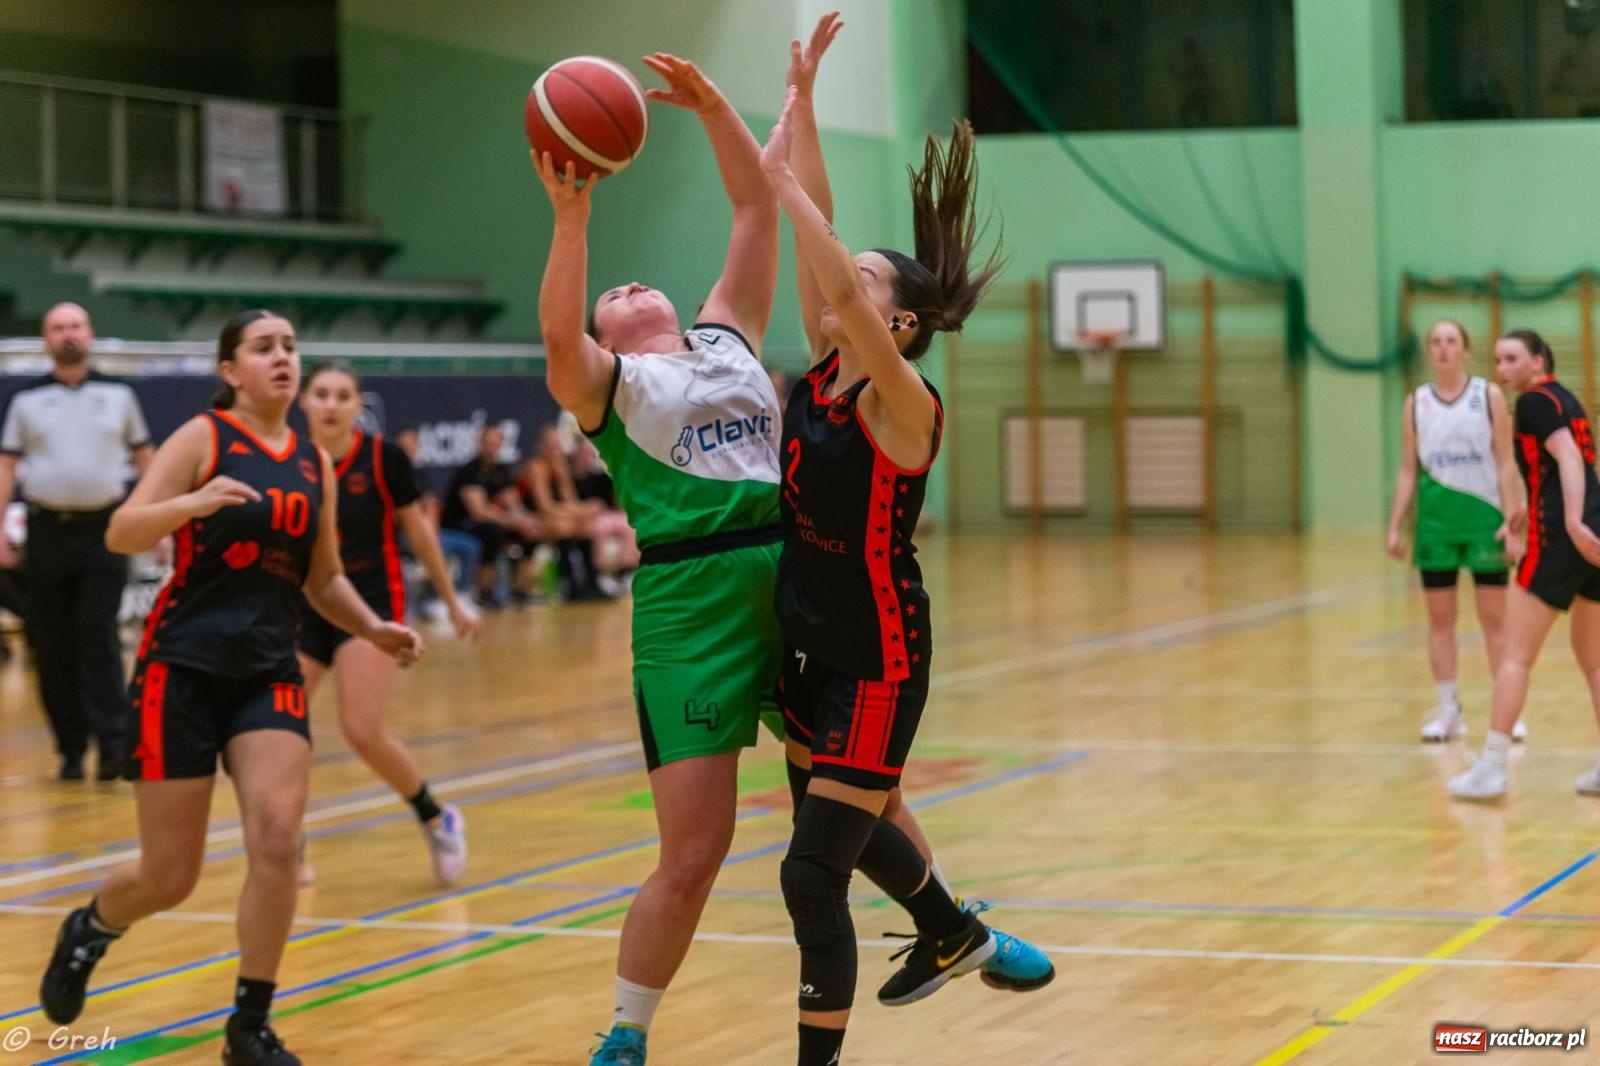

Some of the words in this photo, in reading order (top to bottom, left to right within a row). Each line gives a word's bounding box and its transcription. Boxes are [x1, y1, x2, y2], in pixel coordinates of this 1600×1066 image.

[265, 487, 310, 537] 10
[271, 682, 305, 719] 10
[685, 699, 720, 731] 4
